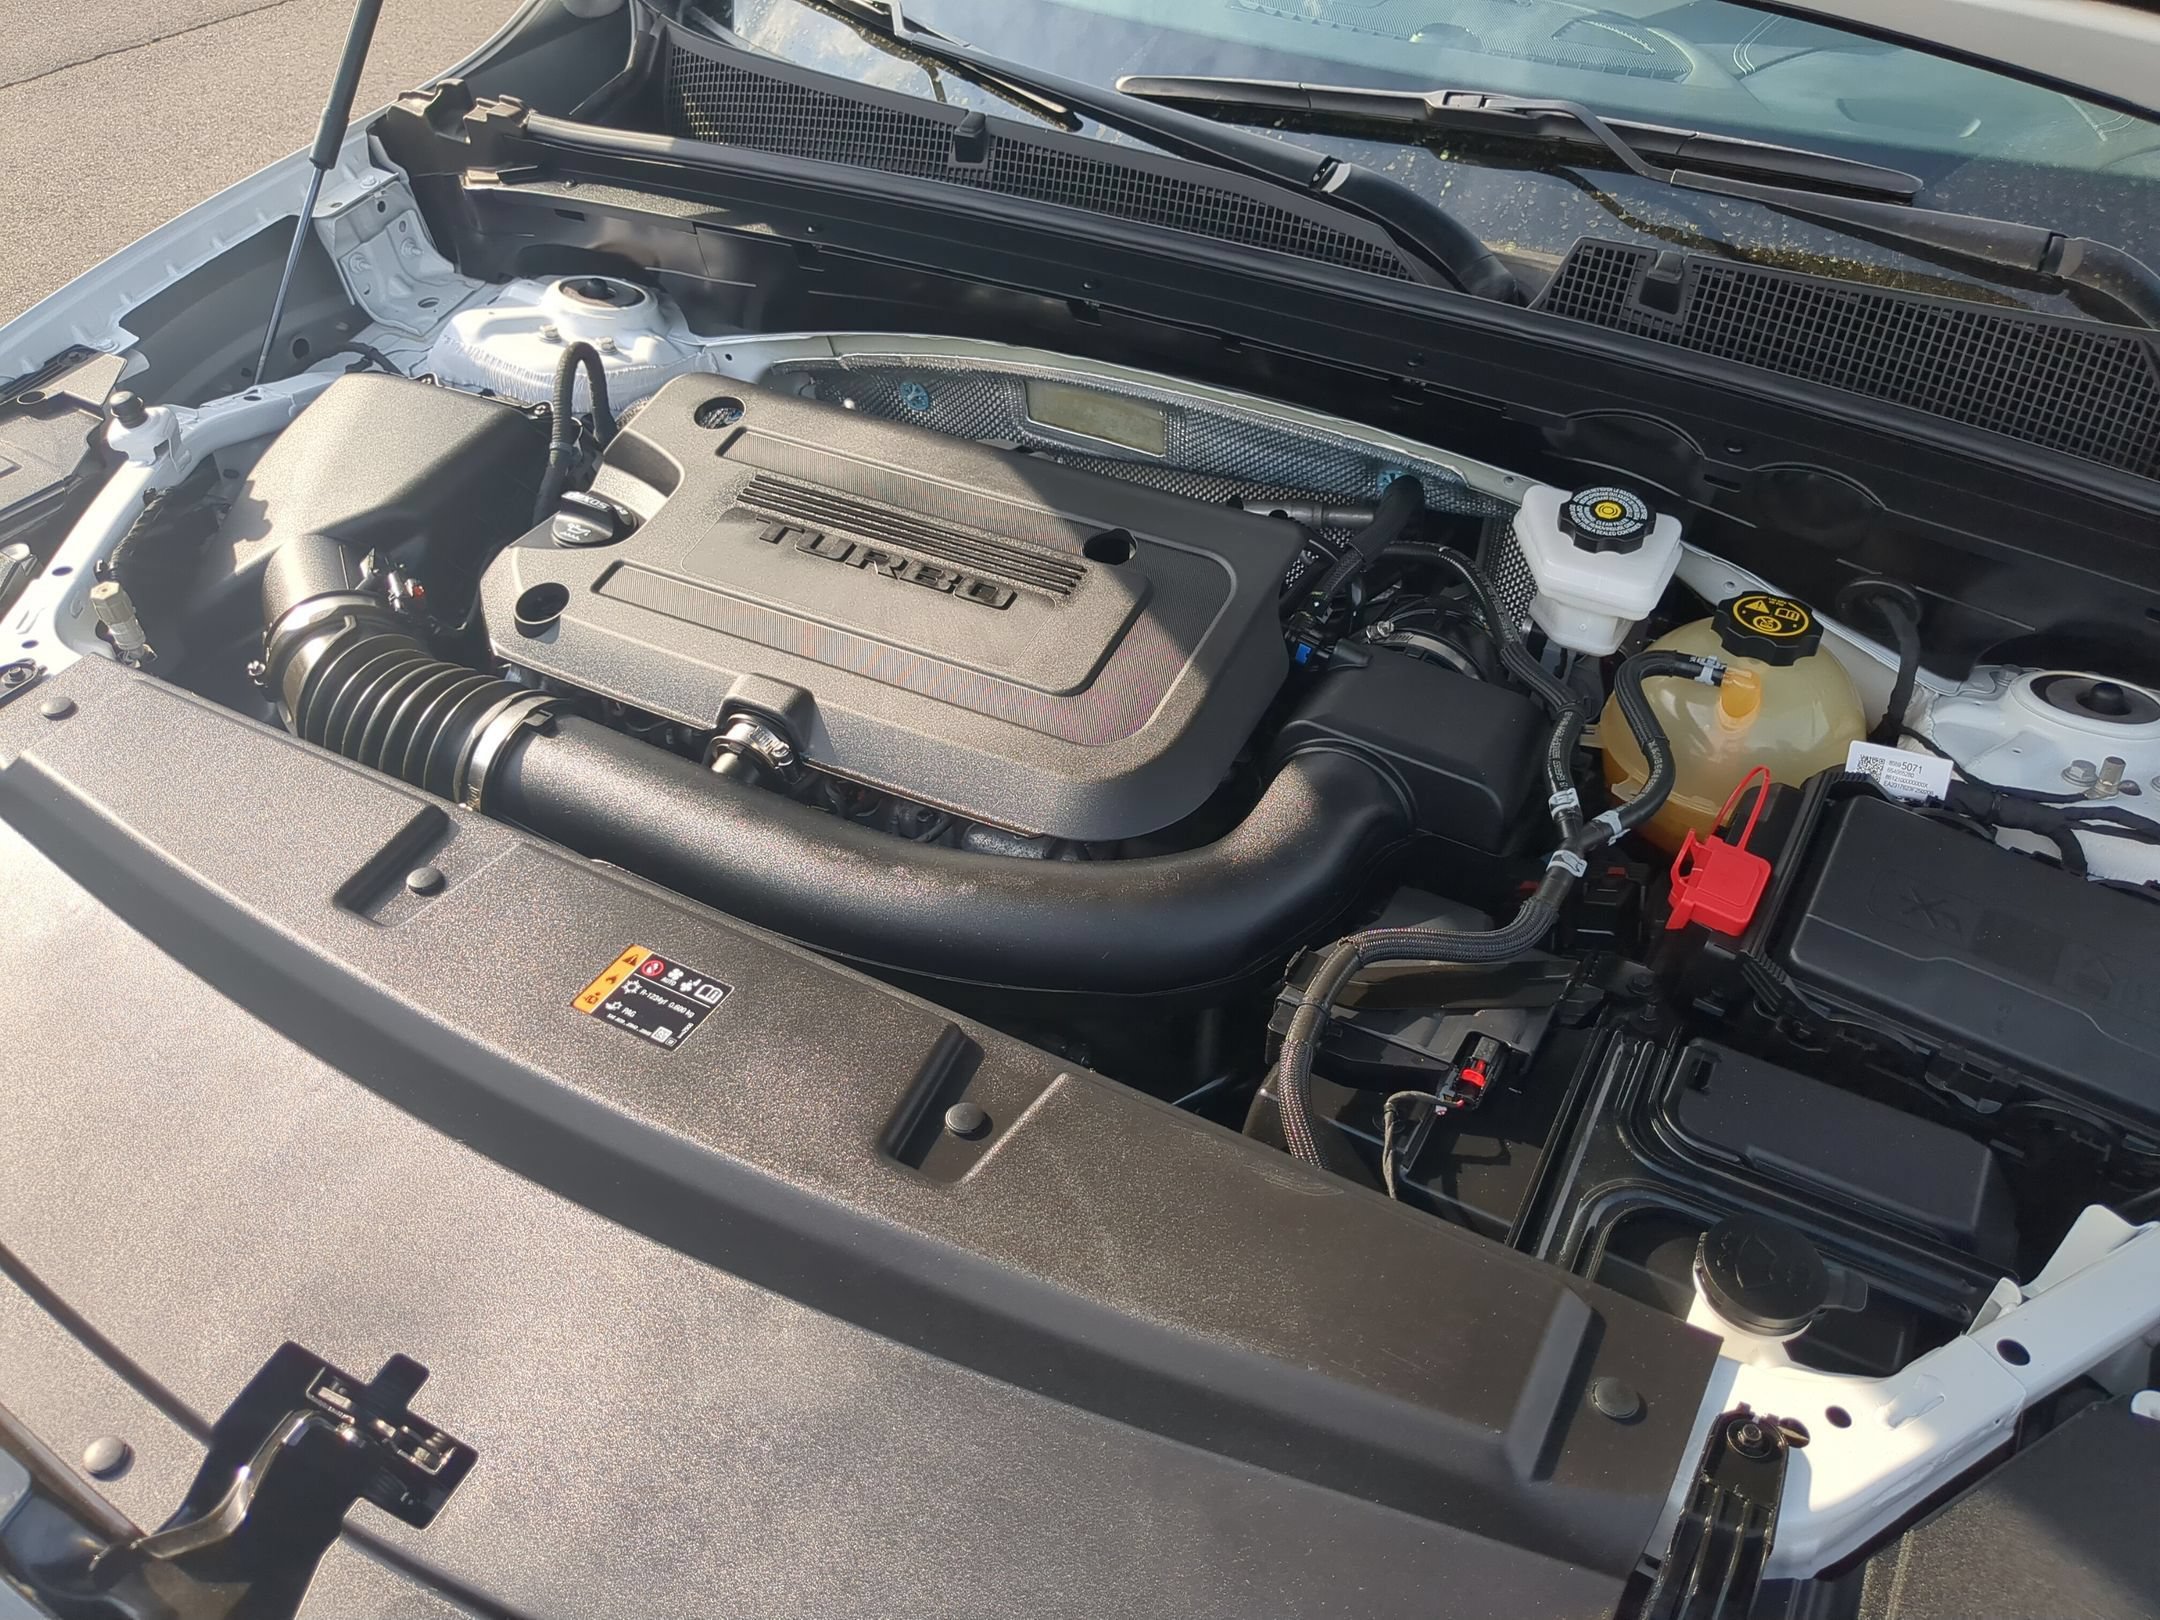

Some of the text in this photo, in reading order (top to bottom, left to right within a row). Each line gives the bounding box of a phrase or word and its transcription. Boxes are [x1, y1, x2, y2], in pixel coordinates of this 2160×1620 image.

[756, 517, 1017, 610] TURBO
[1901, 761, 1922, 774] 5071
[660, 976, 677, 986] AUTO
[621, 1007, 637, 1018] PAG
[685, 1009, 695, 1019] kg
